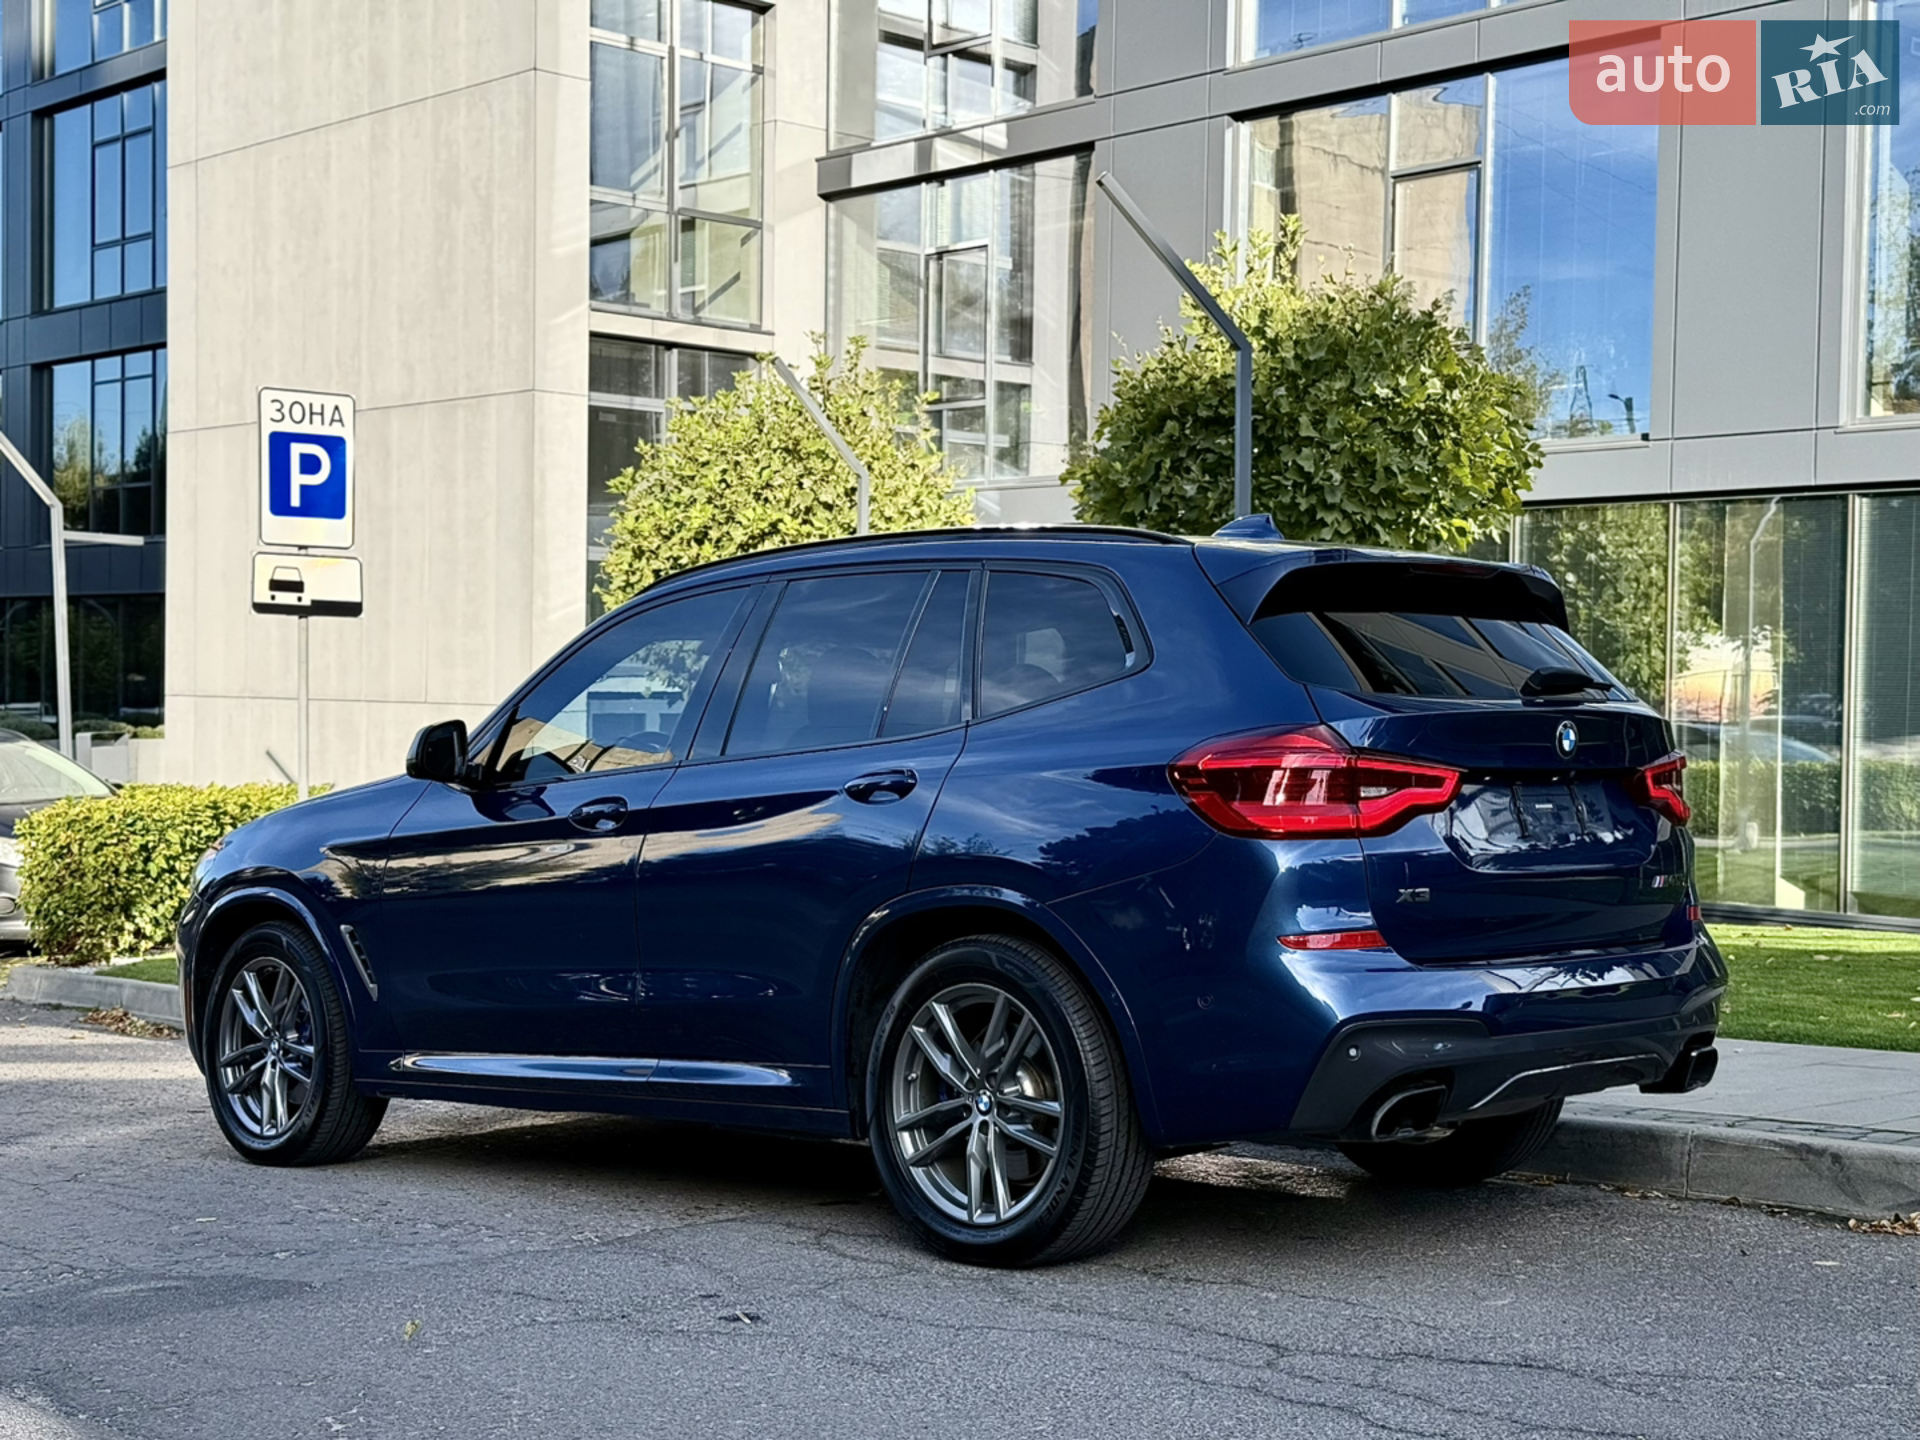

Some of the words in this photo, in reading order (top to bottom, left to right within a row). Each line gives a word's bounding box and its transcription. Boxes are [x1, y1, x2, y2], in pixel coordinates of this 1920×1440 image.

[269, 398, 345, 428] ЗОНА
[289, 441, 332, 508] P
[1395, 887, 1431, 904] X3
